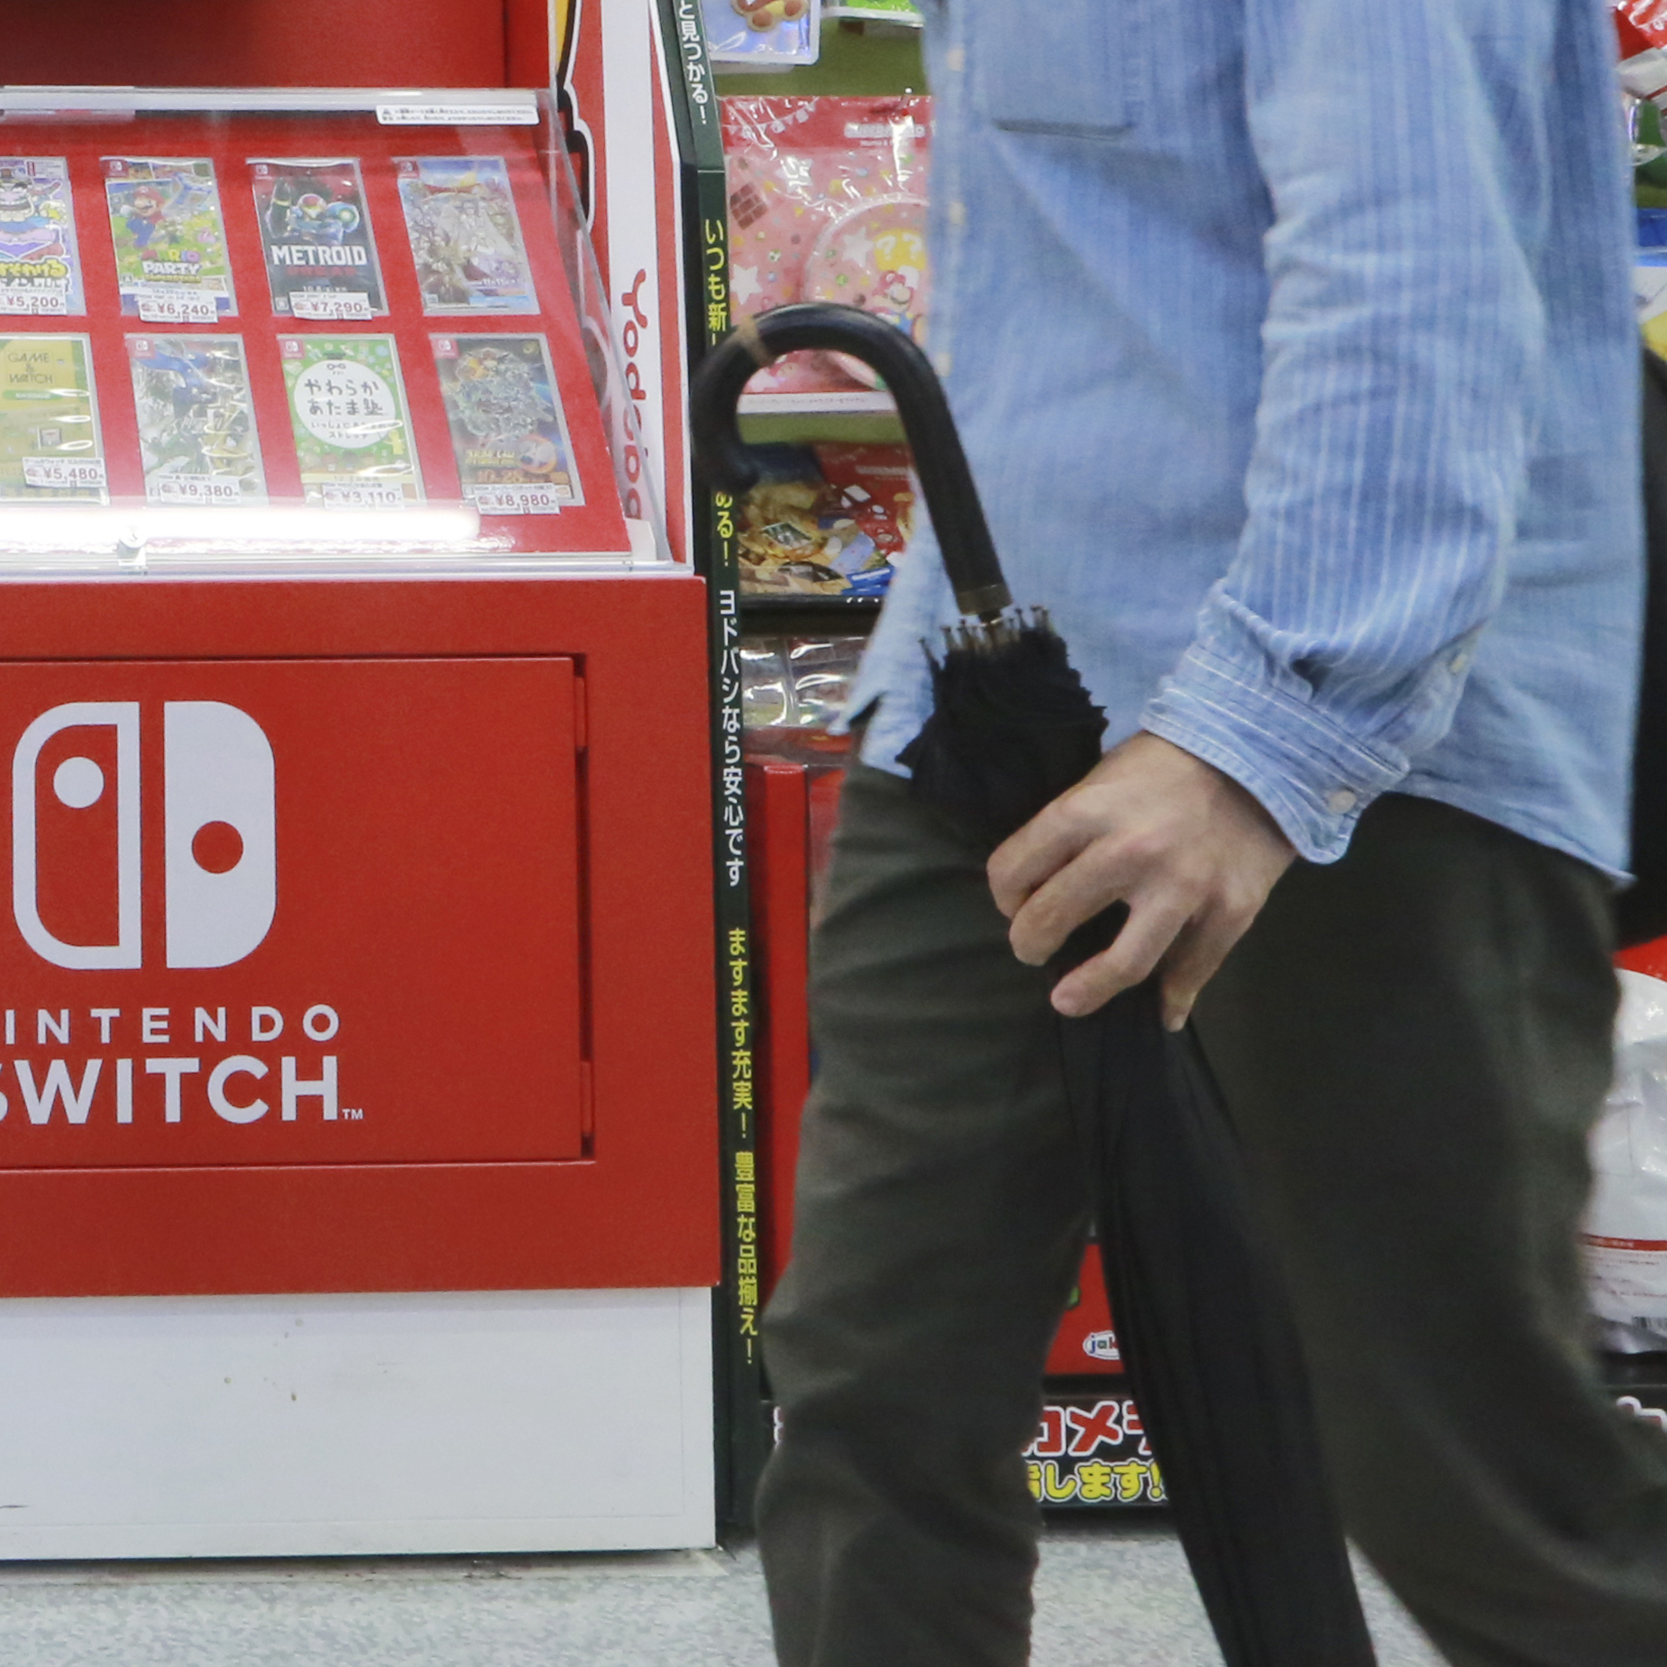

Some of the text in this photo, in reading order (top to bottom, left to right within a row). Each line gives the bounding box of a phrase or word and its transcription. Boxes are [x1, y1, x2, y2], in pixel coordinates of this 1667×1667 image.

[270, 244, 367, 266] METROID
[703, 219, 729, 346] いつも新
[304, 379, 379, 397] やわらか
[720, 589, 744, 888] ヨドバシなら安心です
[728, 927, 754, 1139] ますます充実！
